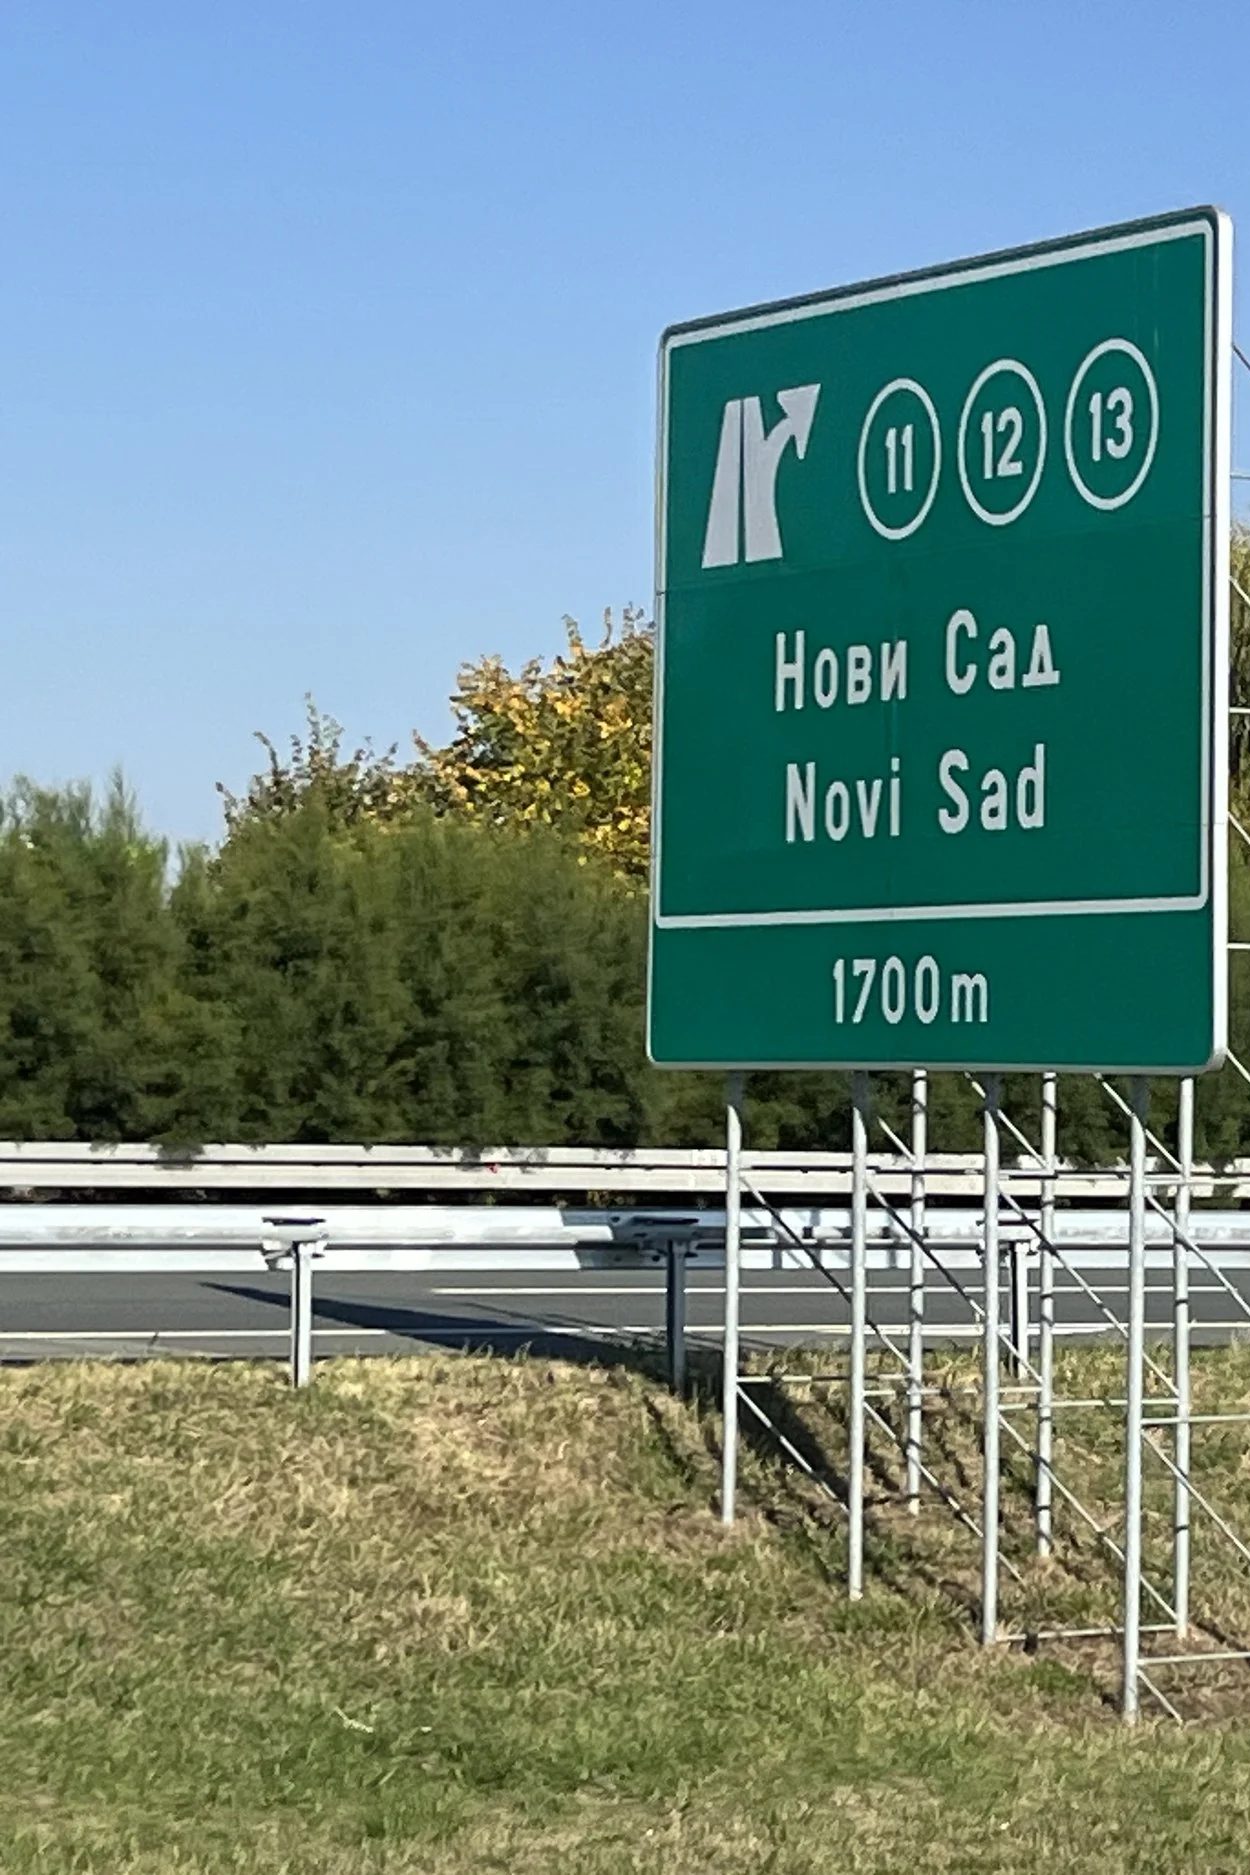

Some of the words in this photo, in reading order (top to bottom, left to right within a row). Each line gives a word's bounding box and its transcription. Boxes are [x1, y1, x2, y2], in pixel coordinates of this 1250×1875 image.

[885, 424, 914, 494] 11
[981, 407, 1024, 479] 12
[1088, 387, 1134, 462] 13
[776, 630, 907, 712] Нови
[946, 609, 1060, 694] Сад
[786, 757, 900, 843] Novi
[938, 743, 1046, 834] Sad
[833, 955, 988, 1024] 1700m
